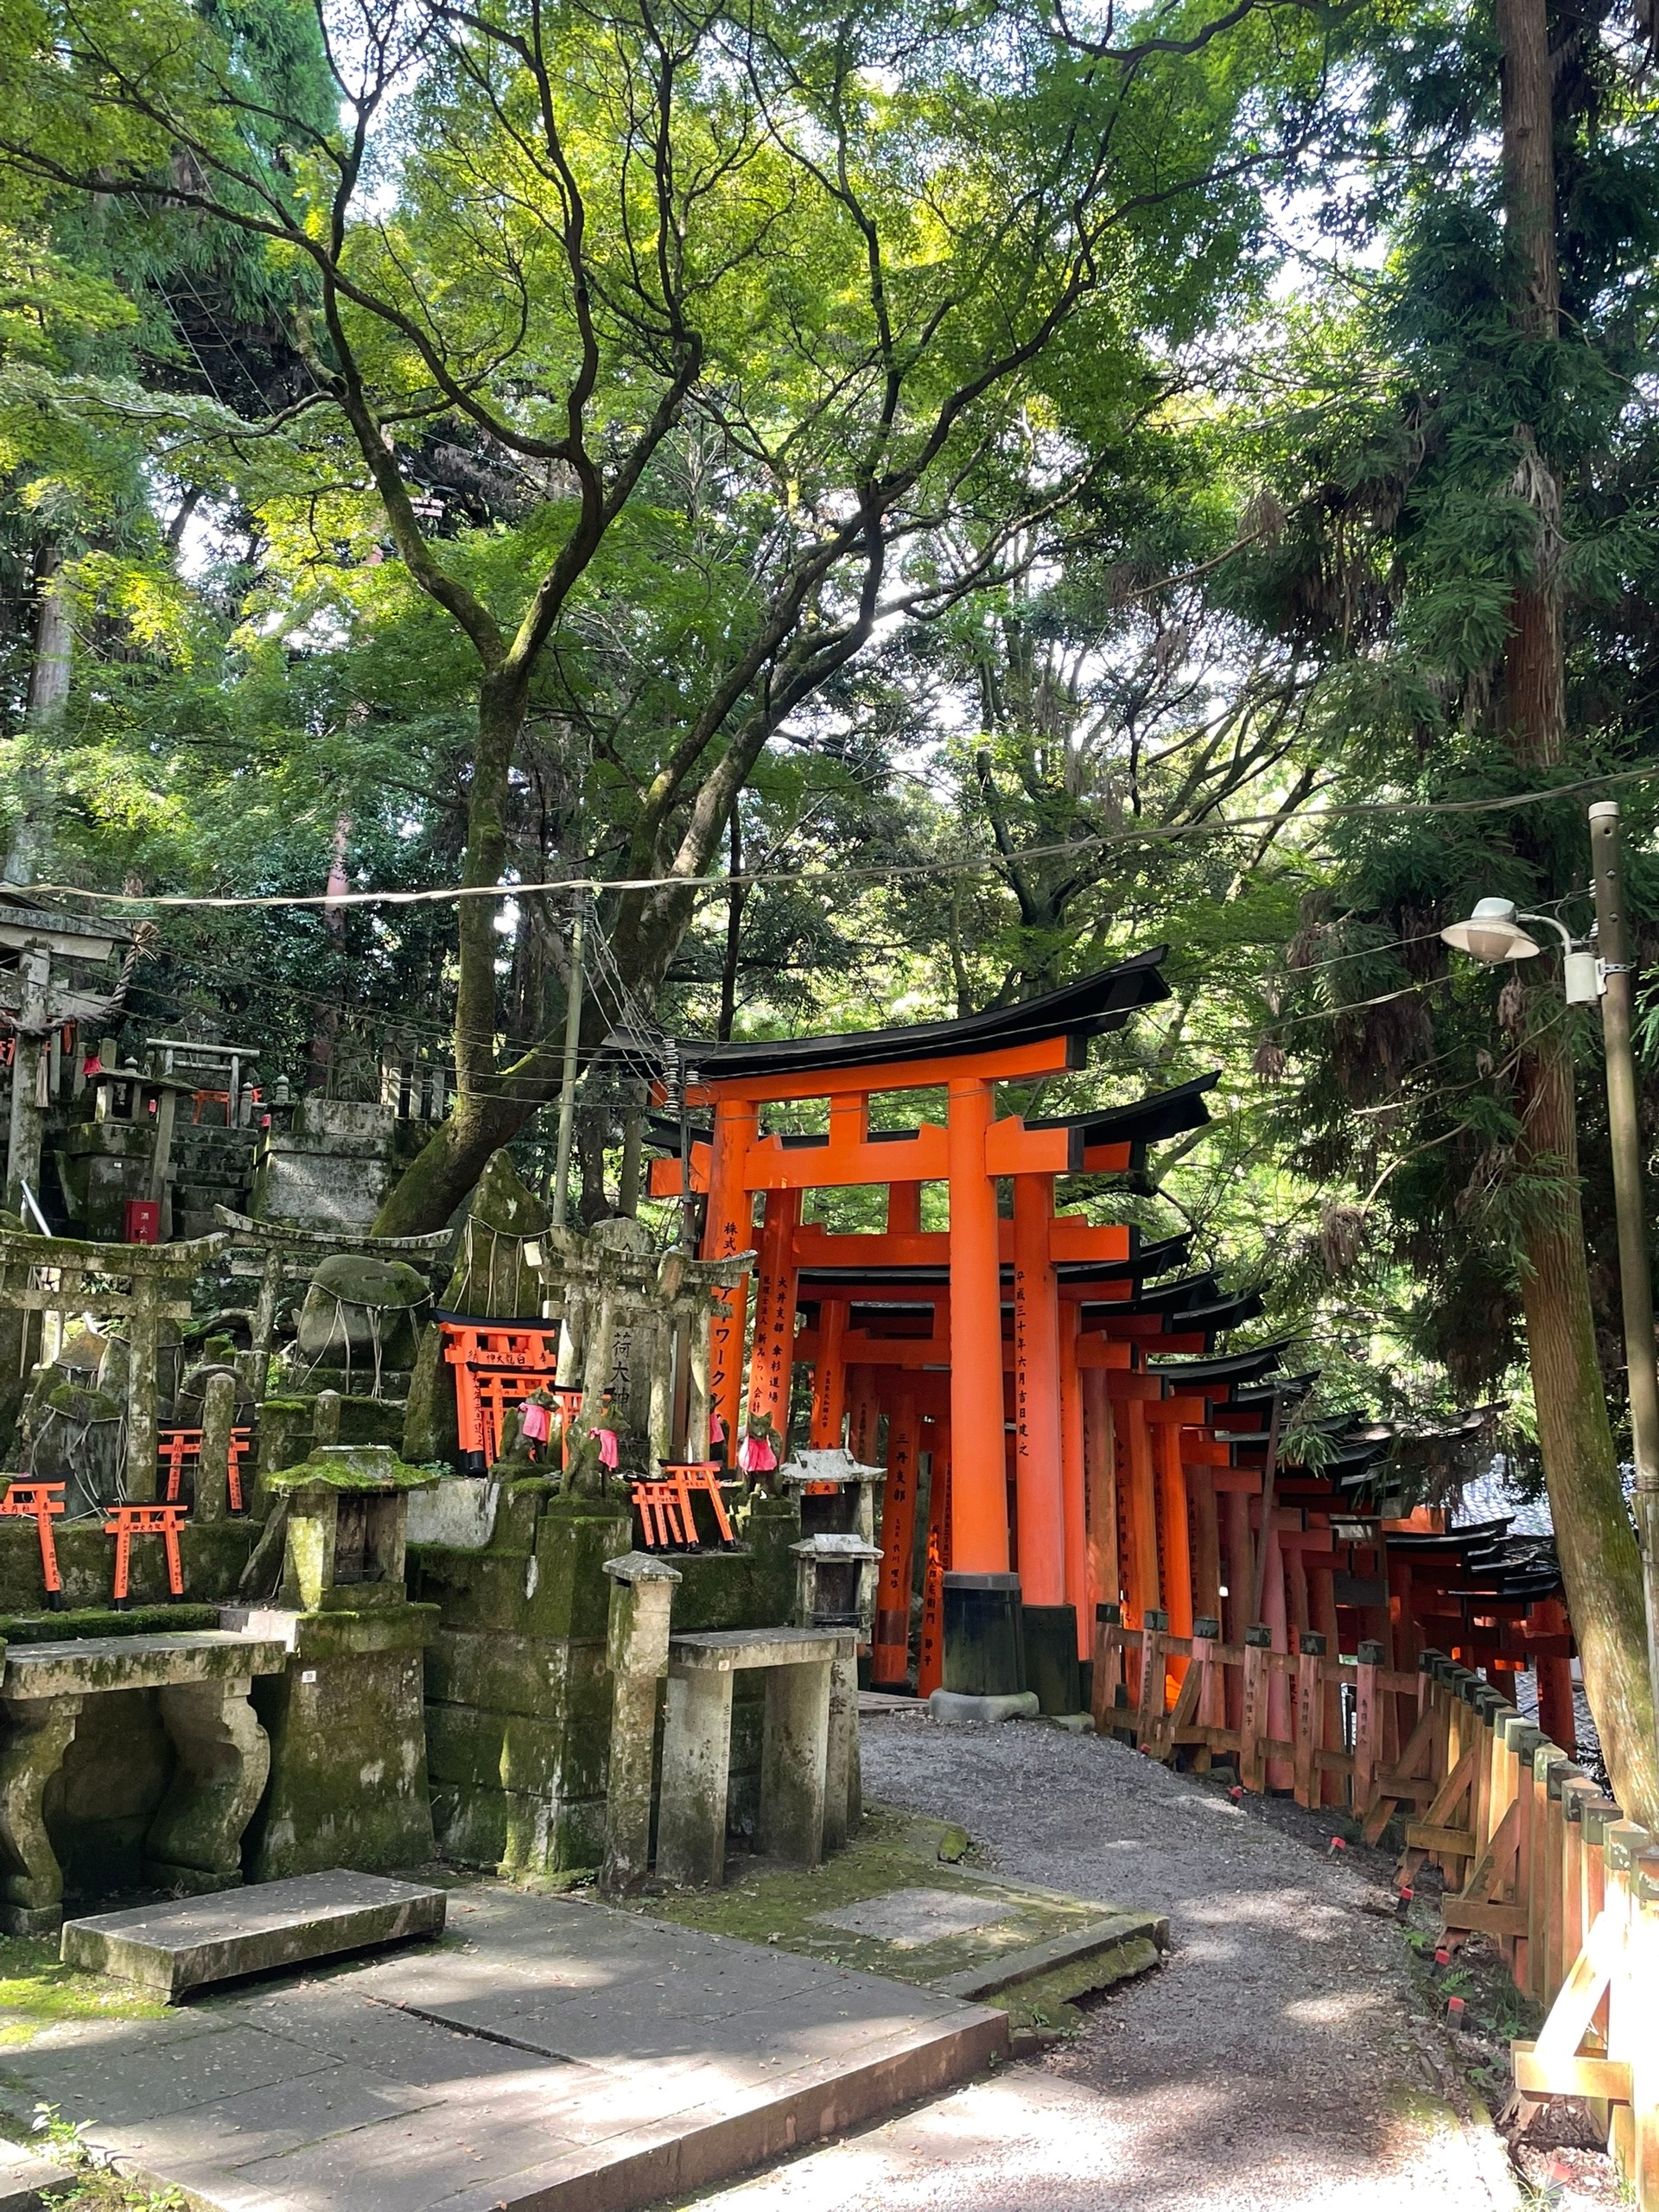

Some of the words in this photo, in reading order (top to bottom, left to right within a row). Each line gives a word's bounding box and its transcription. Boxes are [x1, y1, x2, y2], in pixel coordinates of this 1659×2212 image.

[1016, 1271, 1029, 1457] 平成三十年六月吉日建之
